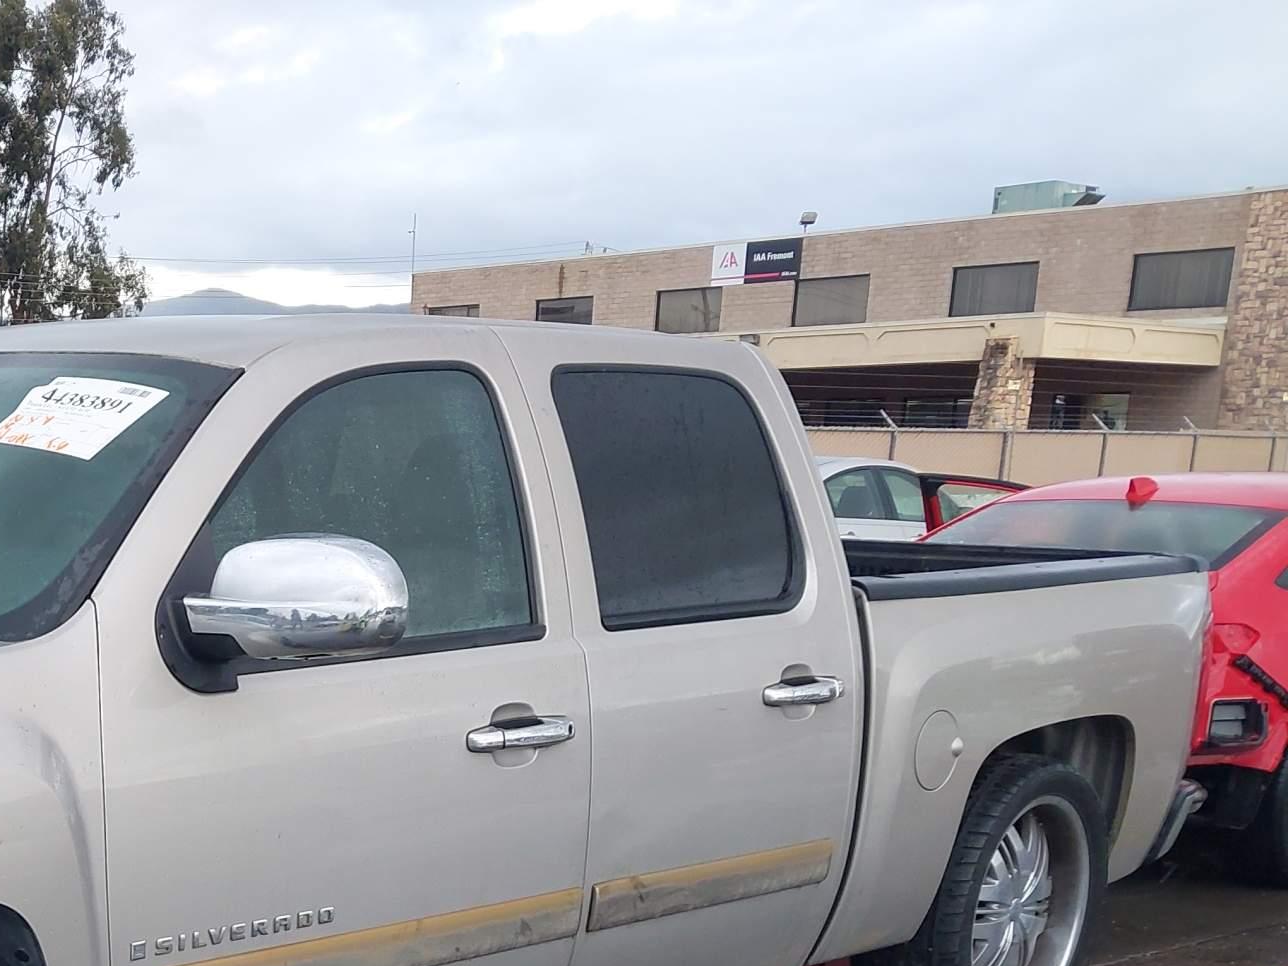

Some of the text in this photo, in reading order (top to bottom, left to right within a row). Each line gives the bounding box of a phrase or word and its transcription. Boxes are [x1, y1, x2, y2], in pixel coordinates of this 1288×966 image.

[753, 250, 794, 262] IAA Fremont
[41, 387, 133, 414] 44383891
[154, 906, 335, 956] SILVERADO
